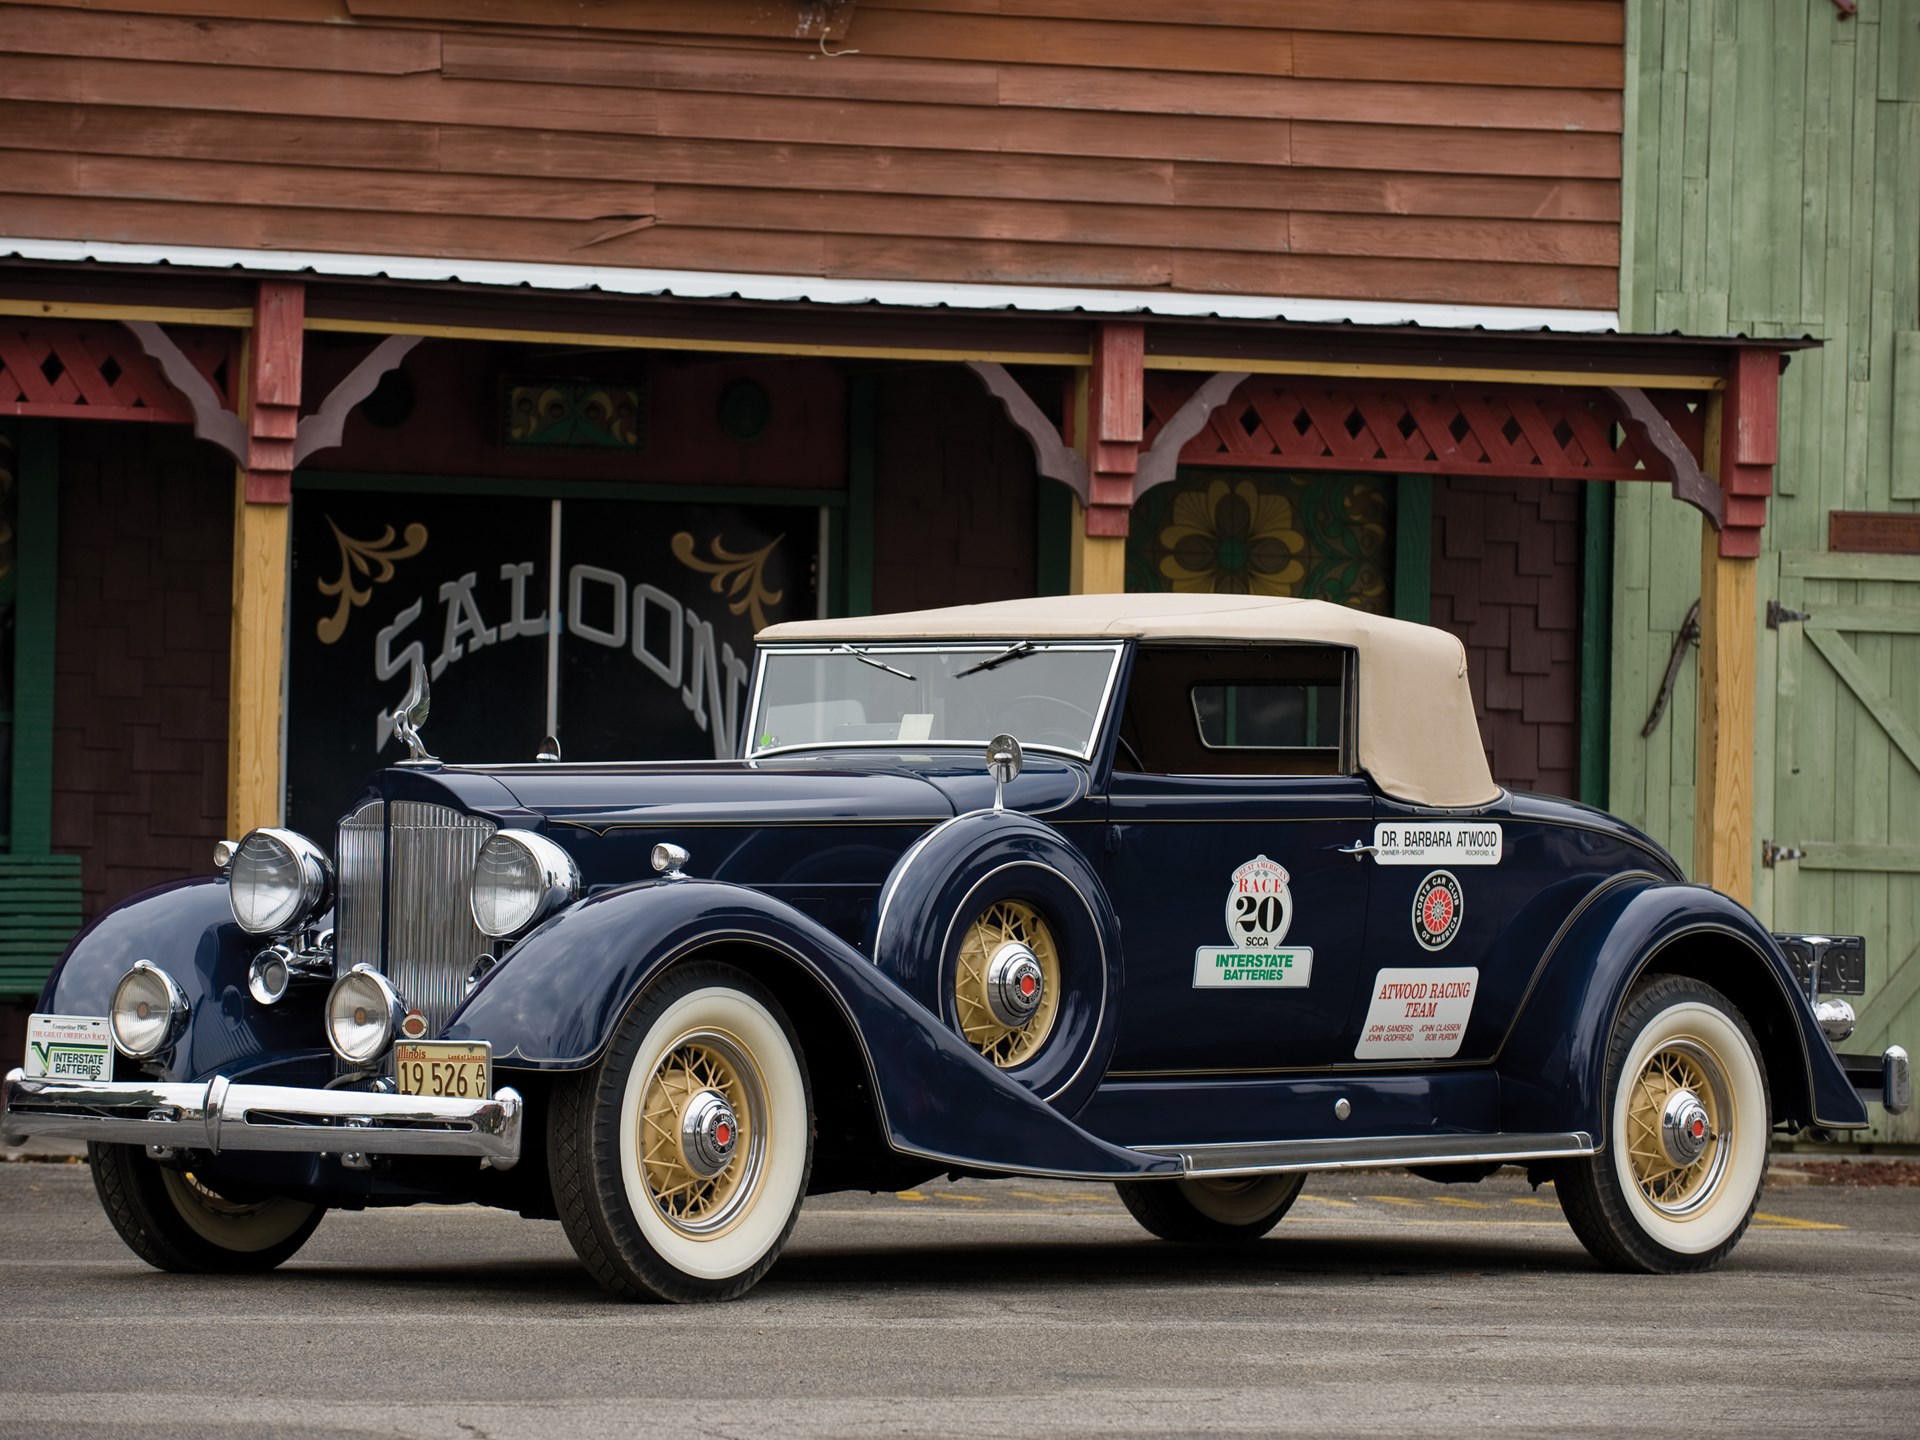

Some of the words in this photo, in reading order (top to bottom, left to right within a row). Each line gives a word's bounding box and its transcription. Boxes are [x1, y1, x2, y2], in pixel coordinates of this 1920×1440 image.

[375, 561, 748, 761] SALOON
[1381, 830, 1399, 847] DR.
[1404, 831, 1452, 847] BARBARA
[1456, 831, 1497, 847] ATWOOD
[1235, 864, 1254, 879] GREAT
[1256, 861, 1287, 880] AMERICAN
[1238, 878, 1283, 893] RACE
[1416, 883, 1431, 923] SPORTS
[1432, 876, 1447, 885] CAR
[1448, 882, 1460, 906] CLUB
[1235, 895, 1283, 933] 20
[1421, 930, 1430, 941] OF
[1431, 916, 1458, 944] AMERICA
[1245, 936, 1269, 947] SCCA
[1215, 954, 1293, 968] INTERSTATE
[1223, 969, 1283, 981] BATTERIES
[1378, 983, 1428, 999] ATWOOD
[1429, 982, 1471, 998] RACING
[1404, 1002, 1438, 1018] TEAM
[32, 1030, 43, 1038] THE
[44, 1031, 62, 1039] GREAT
[92, 1032, 107, 1040] RACE
[1386, 1024, 1414, 1032] SANDERS
[1419, 1024, 1435, 1032] JOHN
[1435, 1023, 1462, 1031] CLASSEN
[1365, 1034, 1382, 1042] JOHN
[53, 1052, 104, 1065] INTERSTATE
[397, 1046, 426, 1059] Illinois
[55, 1064, 101, 1076] BATTERIES
[401, 1062, 424, 1096] 19
[431, 1062, 468, 1097] 526
